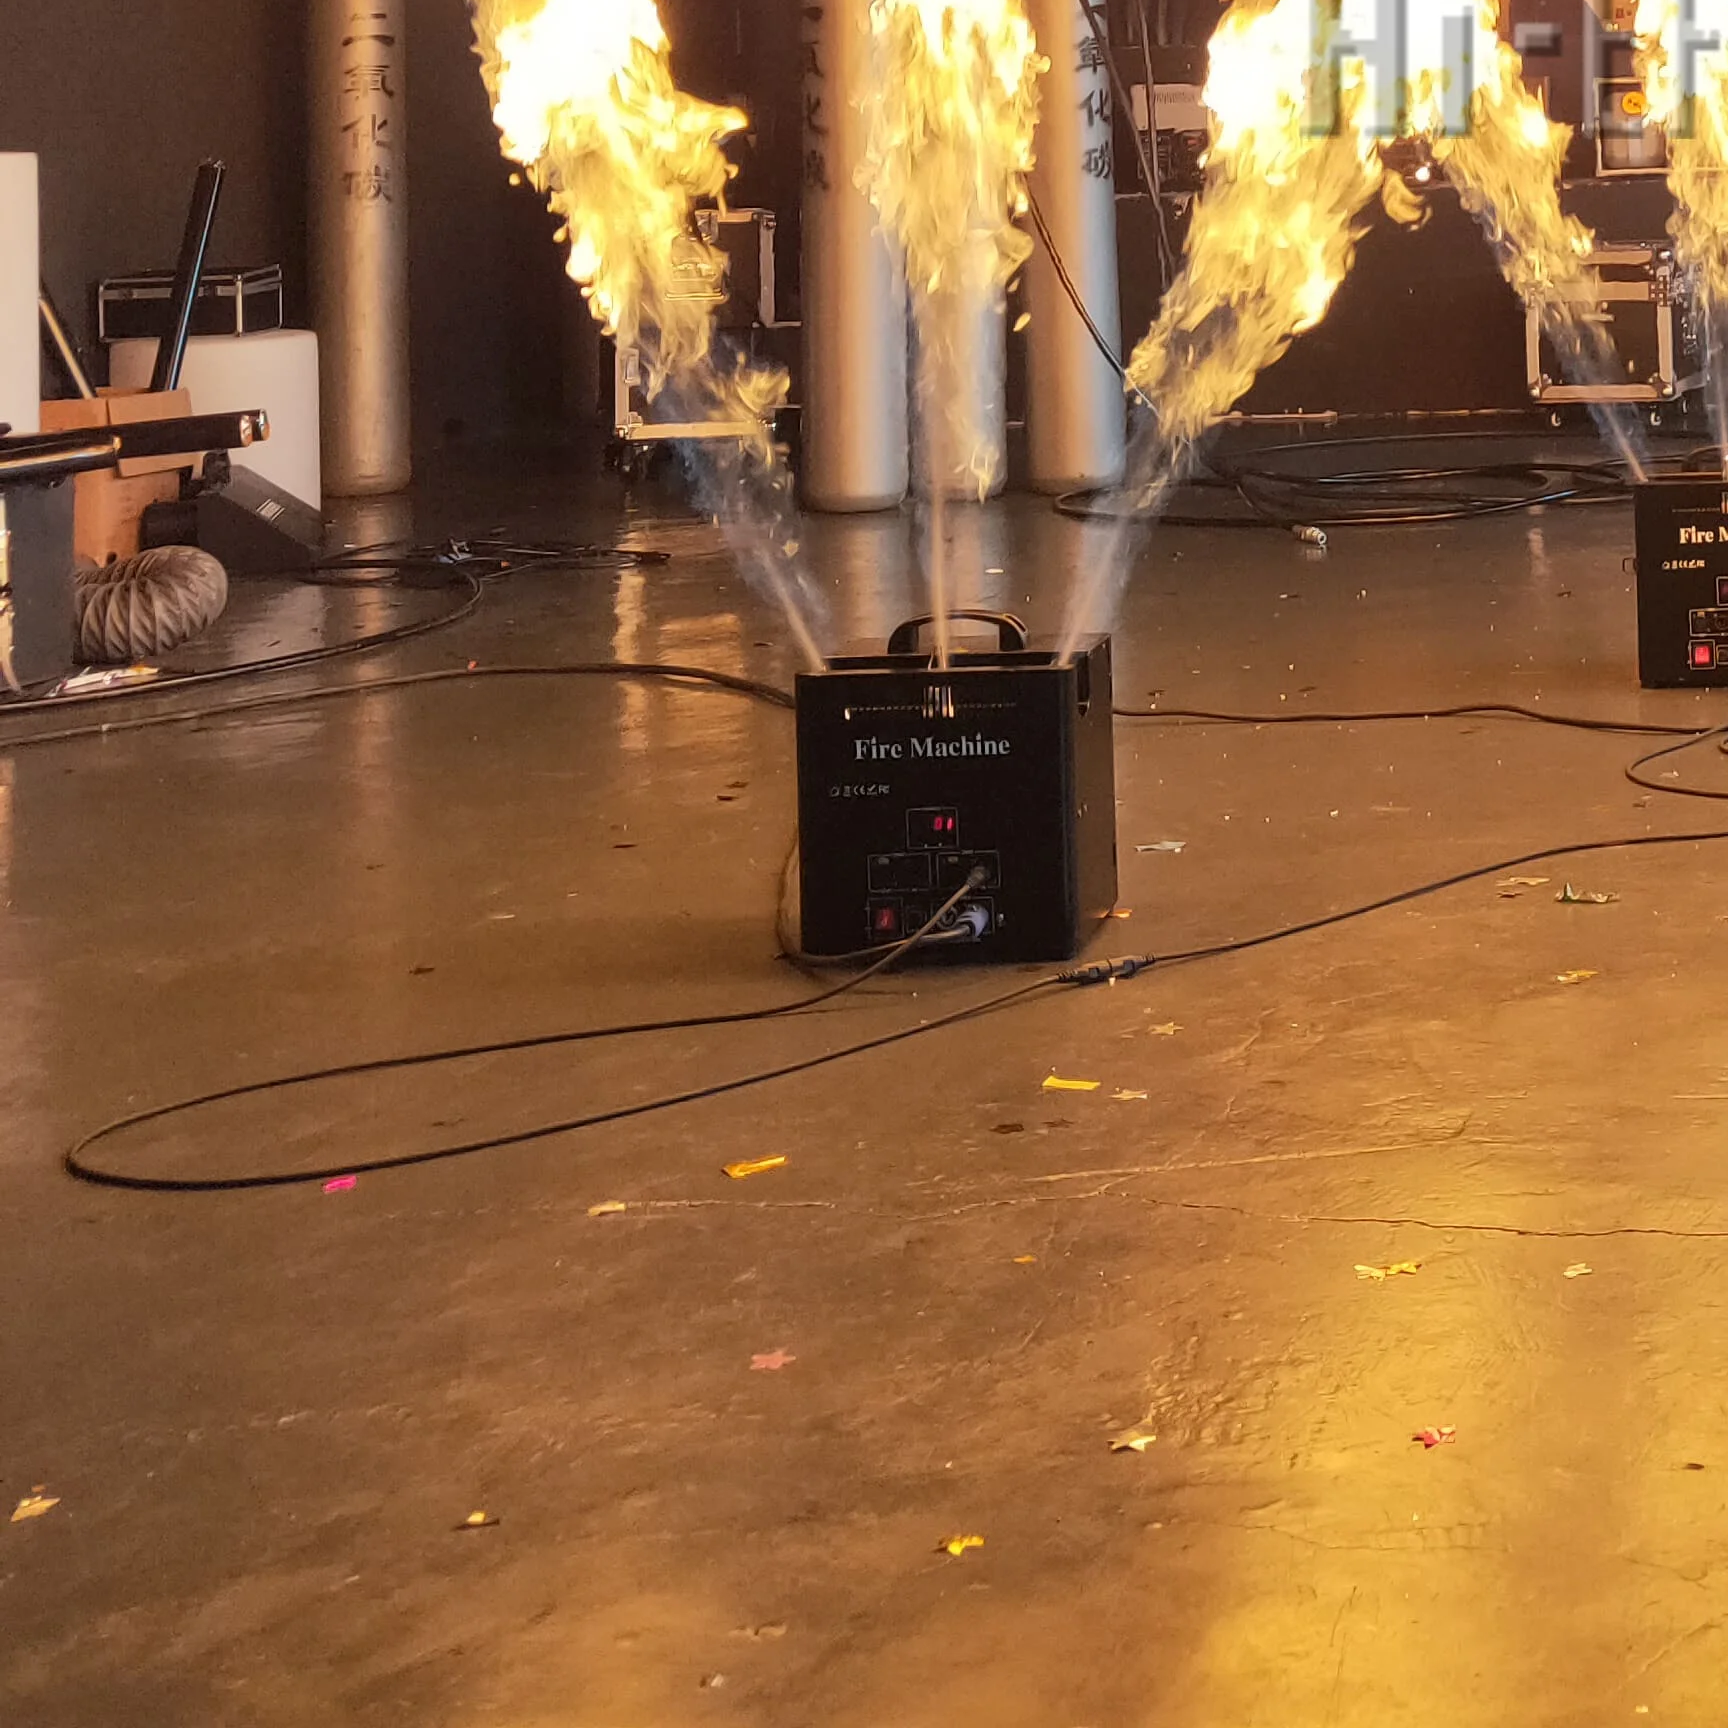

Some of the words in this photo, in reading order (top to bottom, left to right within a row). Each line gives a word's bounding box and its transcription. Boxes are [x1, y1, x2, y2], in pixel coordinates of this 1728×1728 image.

[1678, 525, 1715, 545] Fire
[853, 735, 903, 761] Fire
[909, 731, 1012, 759] Machine
